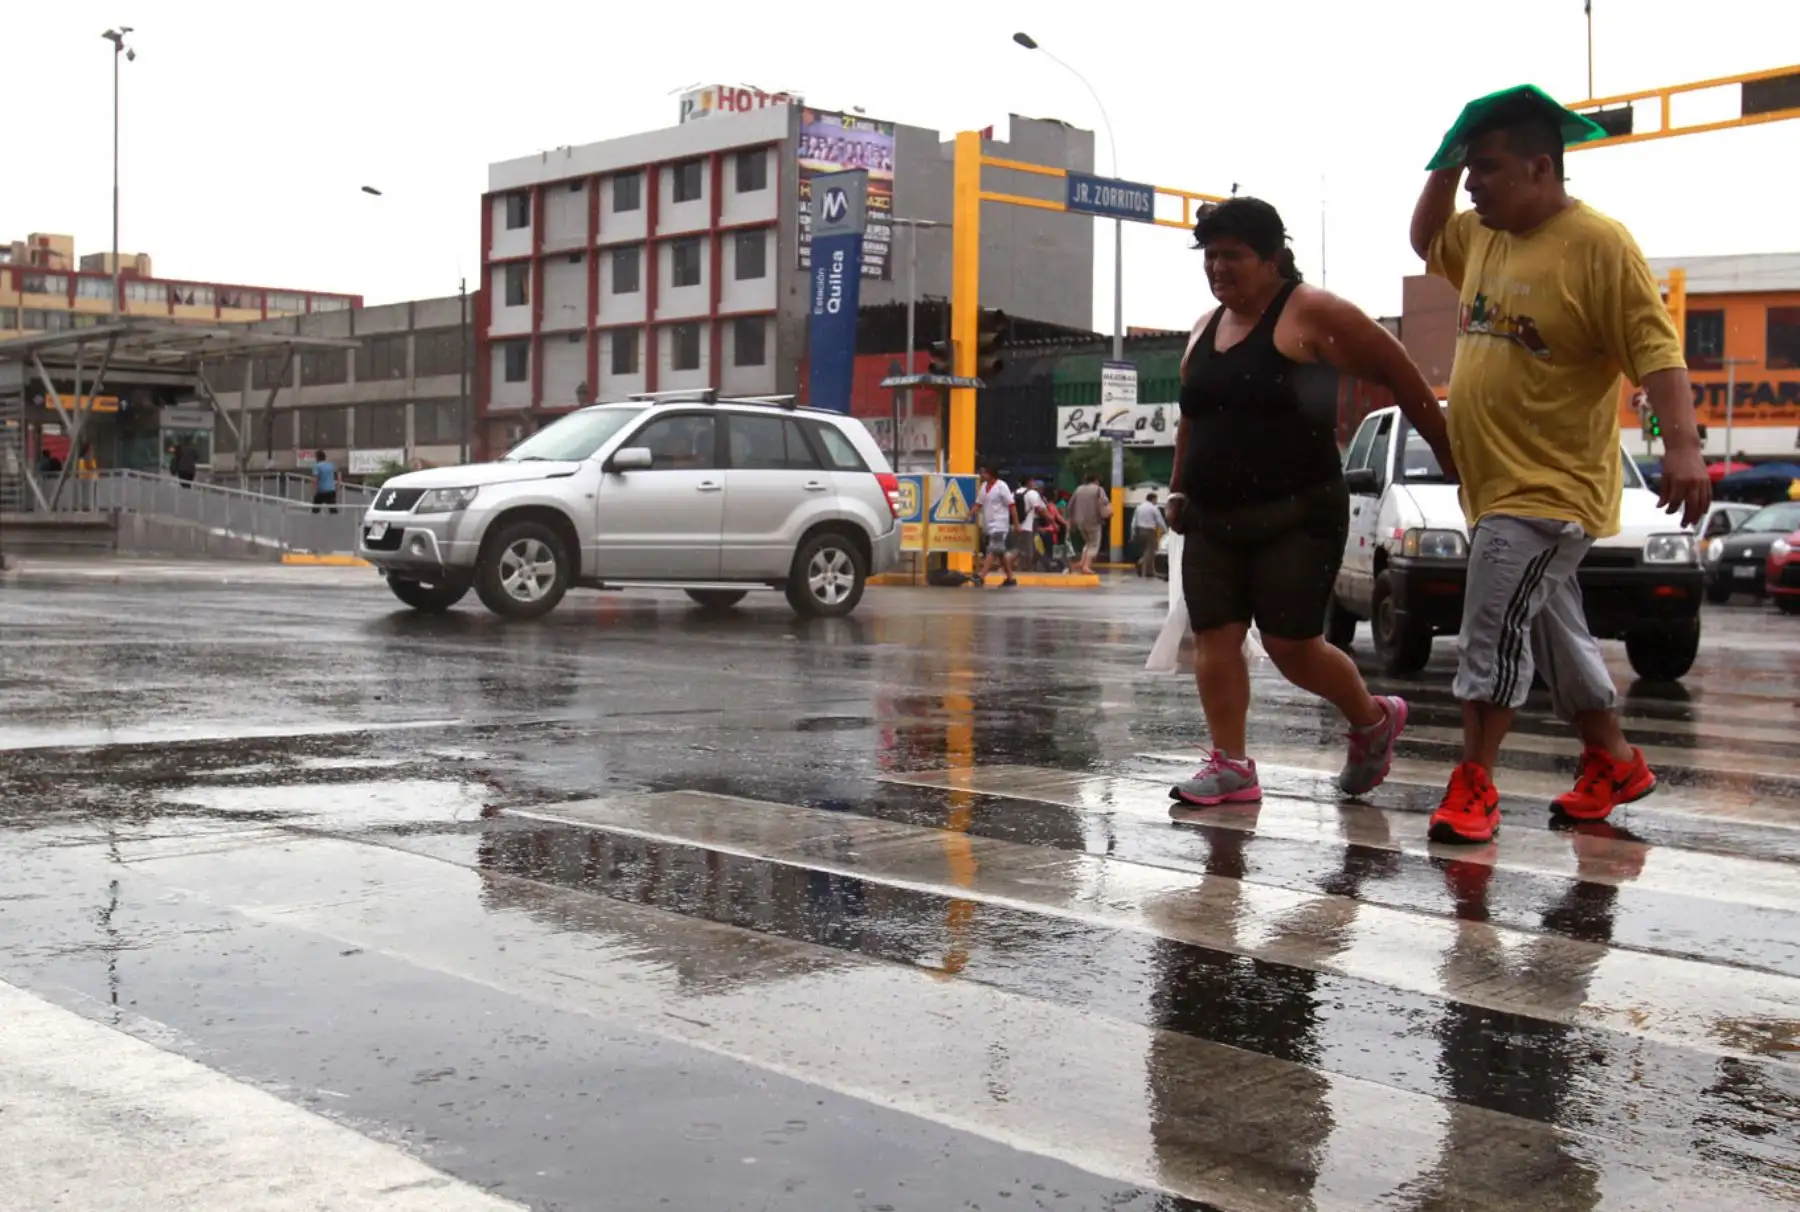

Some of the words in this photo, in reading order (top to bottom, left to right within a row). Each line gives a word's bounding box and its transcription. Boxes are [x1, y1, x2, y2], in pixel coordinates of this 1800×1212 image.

[1072, 183, 1092, 204] JR.
[1094, 185, 1150, 212] ZORRITOS
[814, 267, 826, 315] Estación
[826, 250, 844, 314] Quilca
